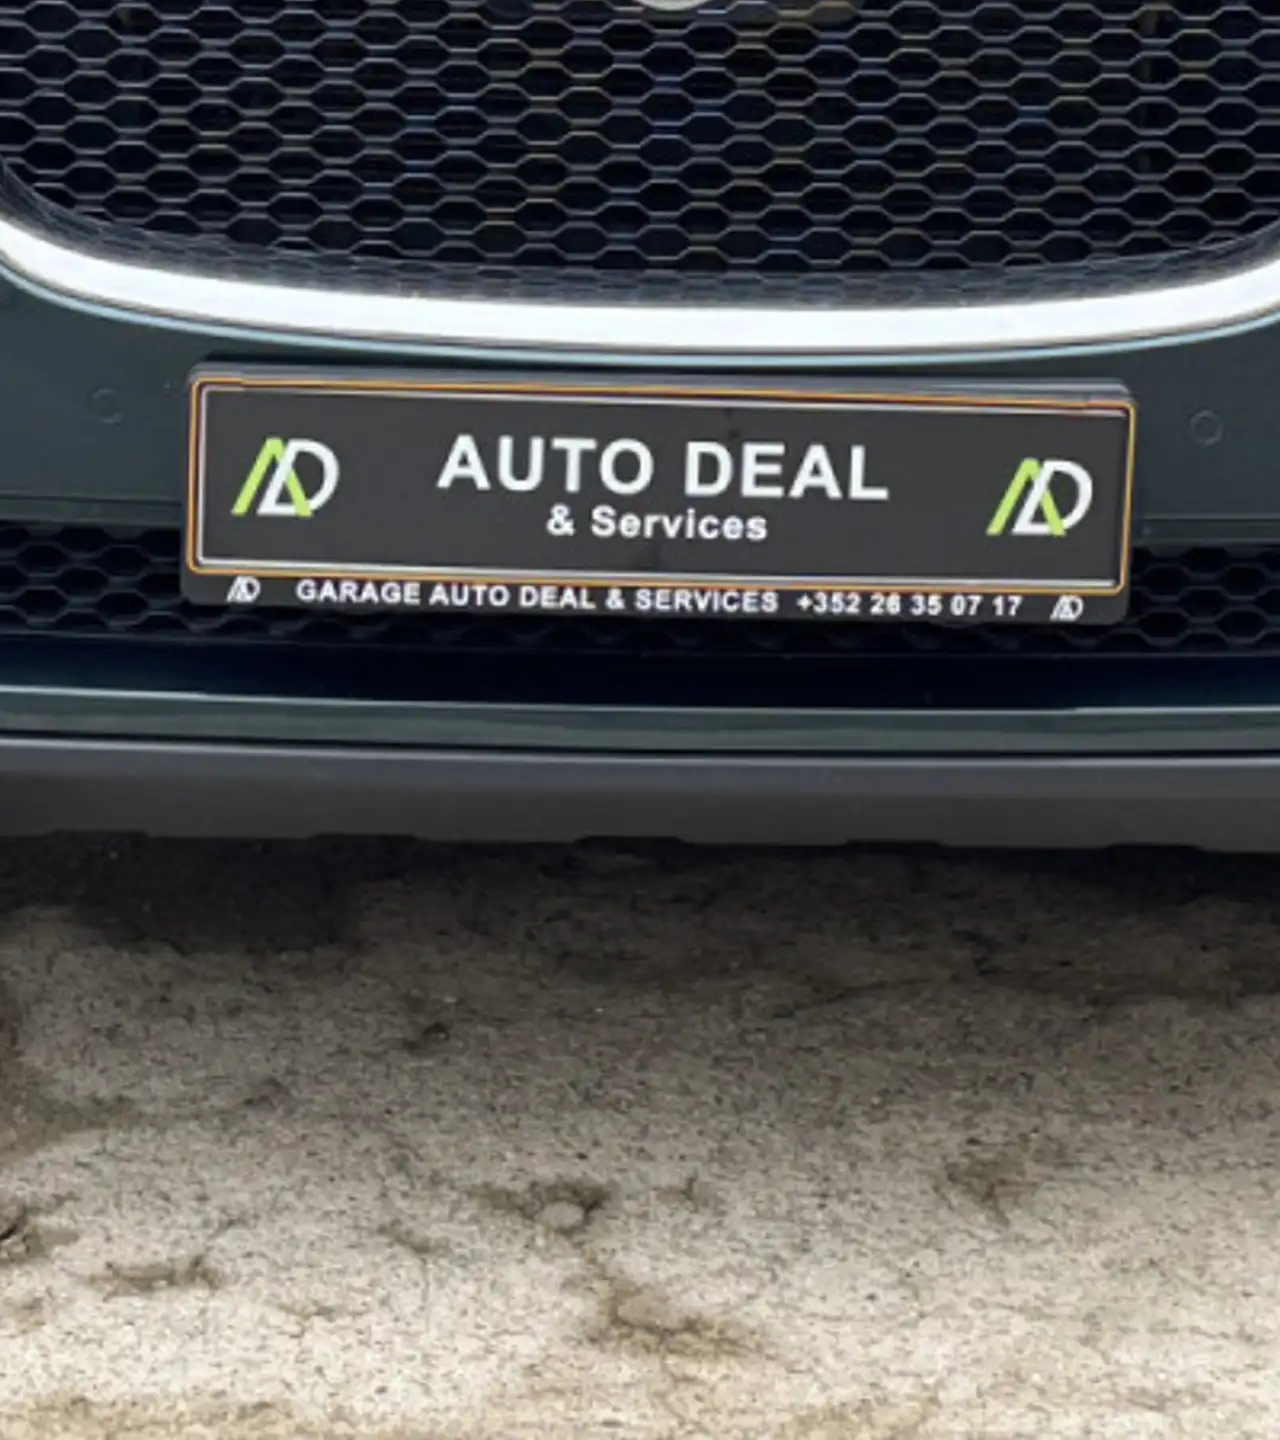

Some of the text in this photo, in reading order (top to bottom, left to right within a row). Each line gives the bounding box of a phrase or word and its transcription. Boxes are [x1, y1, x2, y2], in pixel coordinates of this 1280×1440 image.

[436, 434, 890, 500] AUTO DEAL
[545, 504, 769, 542] & Services
[296, 579, 420, 604] GARAGE
[429, 582, 510, 607] AUTO
[519, 586, 596, 610] DEAL
[606, 586, 626, 610] &
[634, 587, 780, 614] SERVICES
[796, 591, 861, 615] +352
[909, 594, 942, 618] 35
[950, 595, 984, 618] 07
[992, 595, 1023, 619] 17
